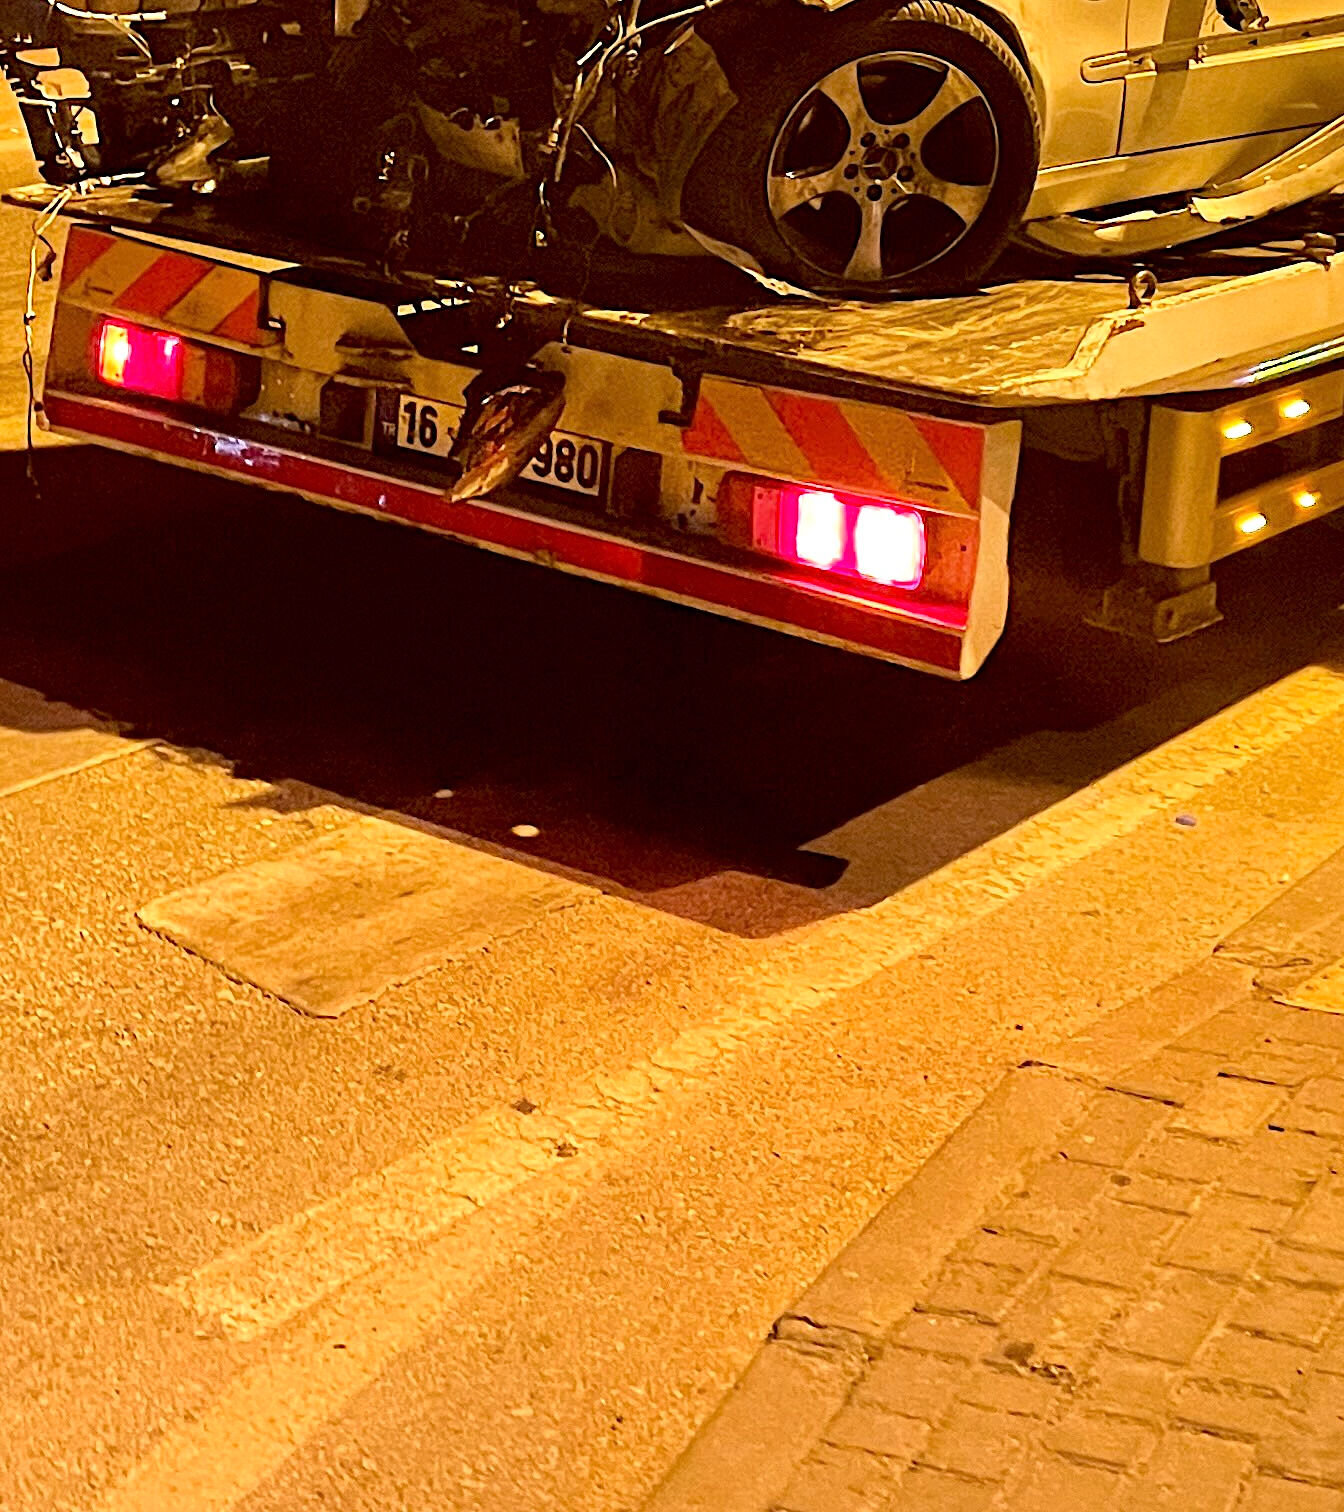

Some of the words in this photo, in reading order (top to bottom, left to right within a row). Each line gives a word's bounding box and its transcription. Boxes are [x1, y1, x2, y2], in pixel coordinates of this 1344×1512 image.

[381, 420, 397, 437] TR
[403, 400, 439, 448] 16
[532, 438, 599, 489] 980
